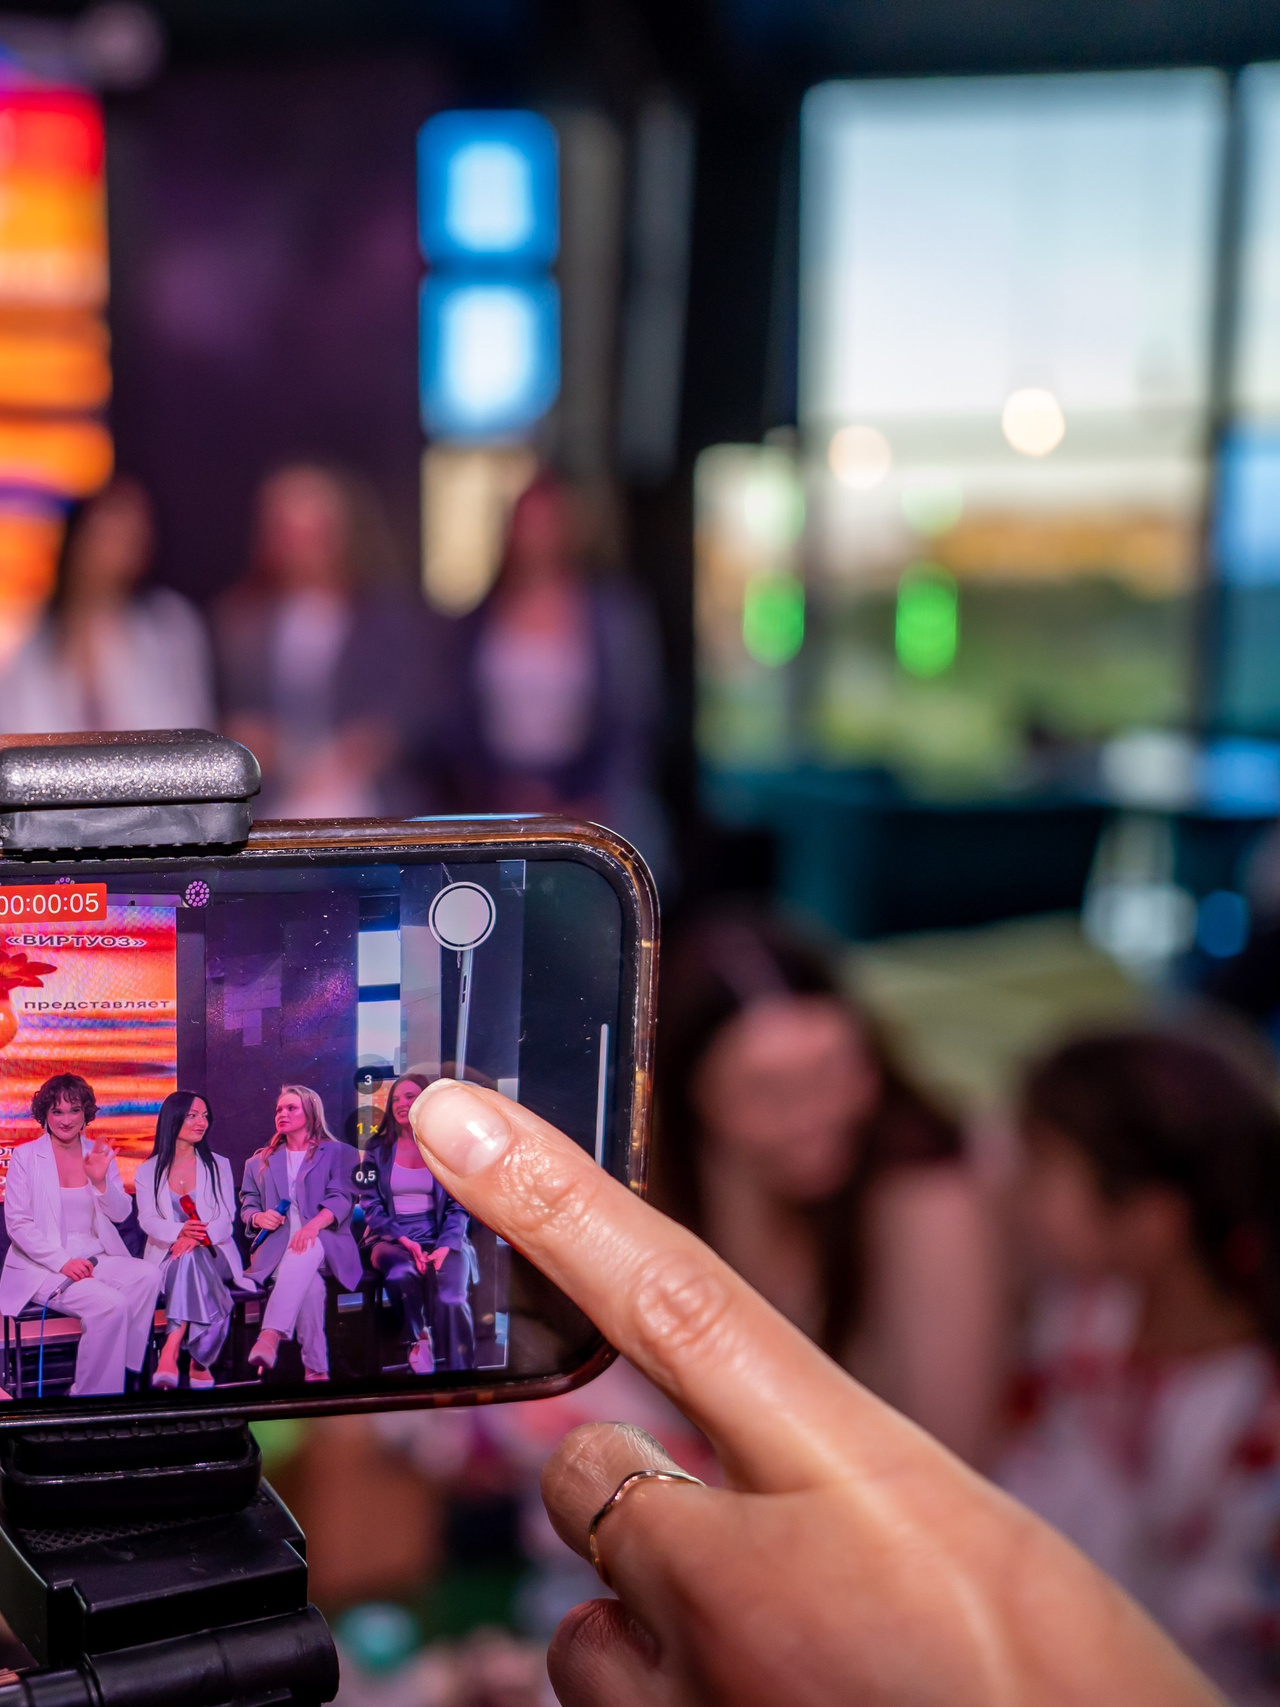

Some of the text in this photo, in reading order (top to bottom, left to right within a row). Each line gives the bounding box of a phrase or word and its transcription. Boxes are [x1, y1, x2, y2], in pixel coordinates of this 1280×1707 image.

[7, 934, 147, 948] «ВИРТУОЗ»
[23, 1000, 170, 1011] представляет
[364, 1074, 373, 1086] 3
